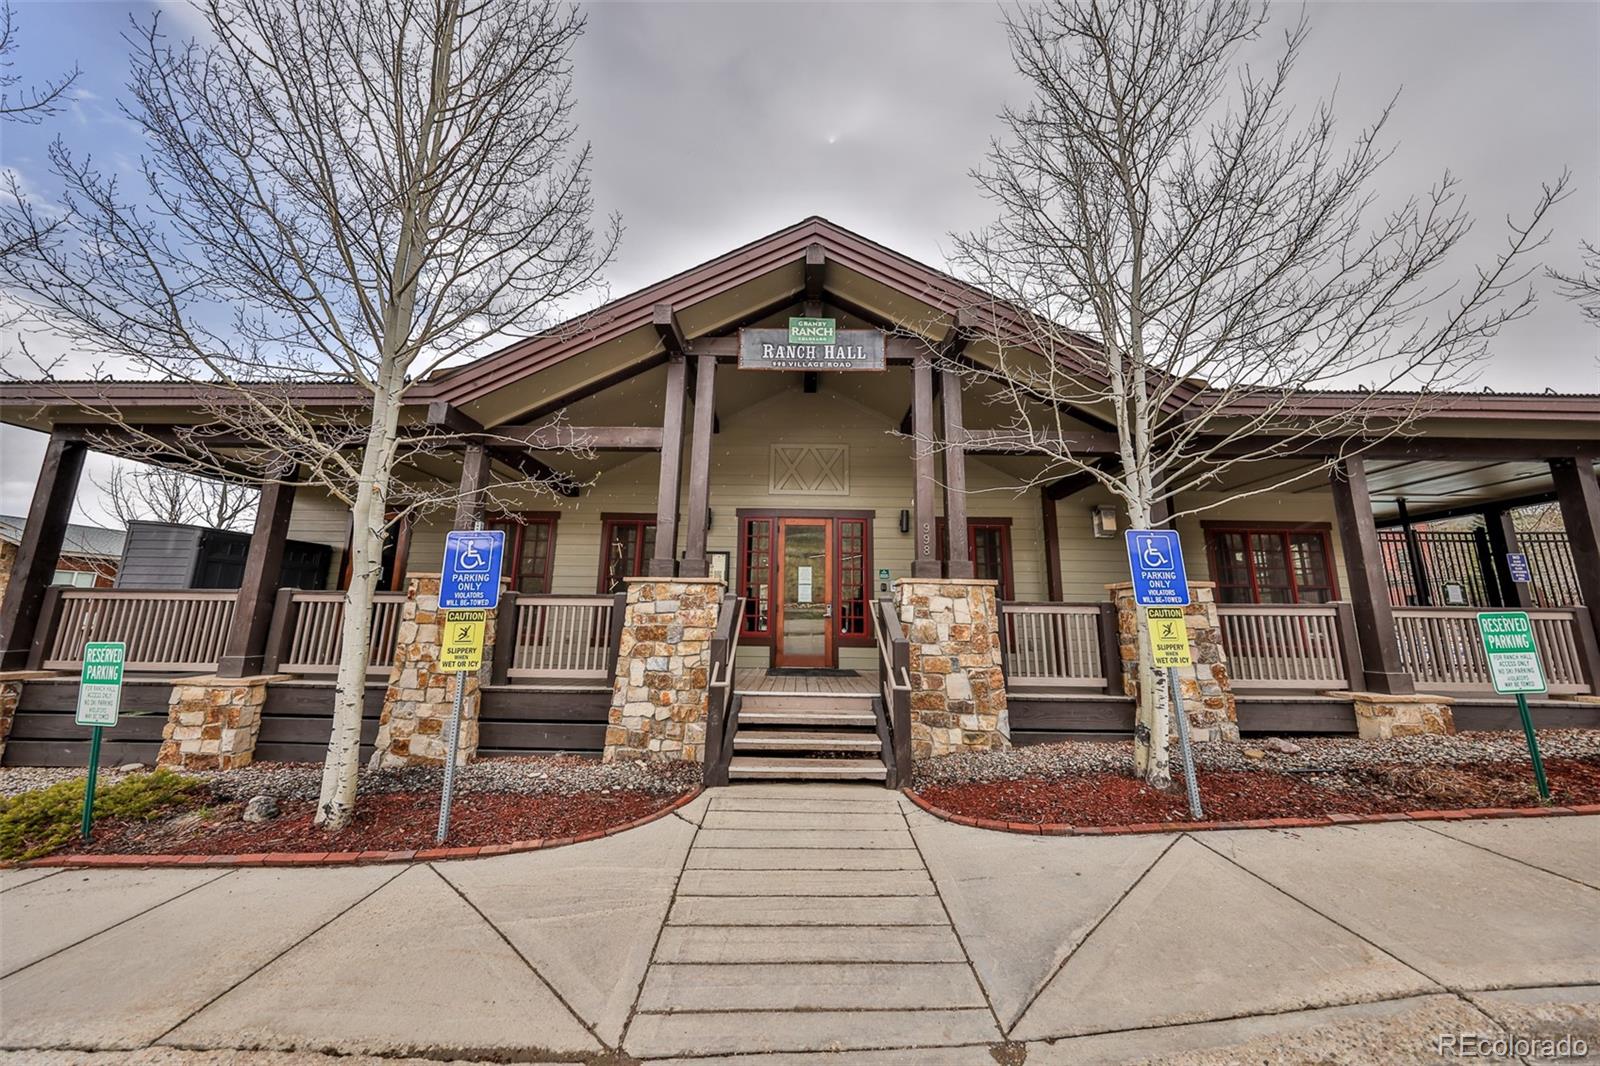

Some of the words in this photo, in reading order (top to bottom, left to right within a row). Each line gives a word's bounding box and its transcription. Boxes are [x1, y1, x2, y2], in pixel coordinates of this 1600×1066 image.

[791, 327, 834, 336] RANCH
[762, 344, 816, 359] RANCH
[824, 345, 866, 360] HALL
[452, 574, 490, 582] PARKING
[1141, 571, 1177, 580] PARKING
[448, 612, 484, 620] CAUTION
[1149, 609, 1182, 618] CAUTION
[1481, 618, 1528, 632] RESERVED
[1488, 634, 1530, 649] PARKING
[86, 648, 122, 663] RESERVED
[86, 665, 119, 680] PARKING
